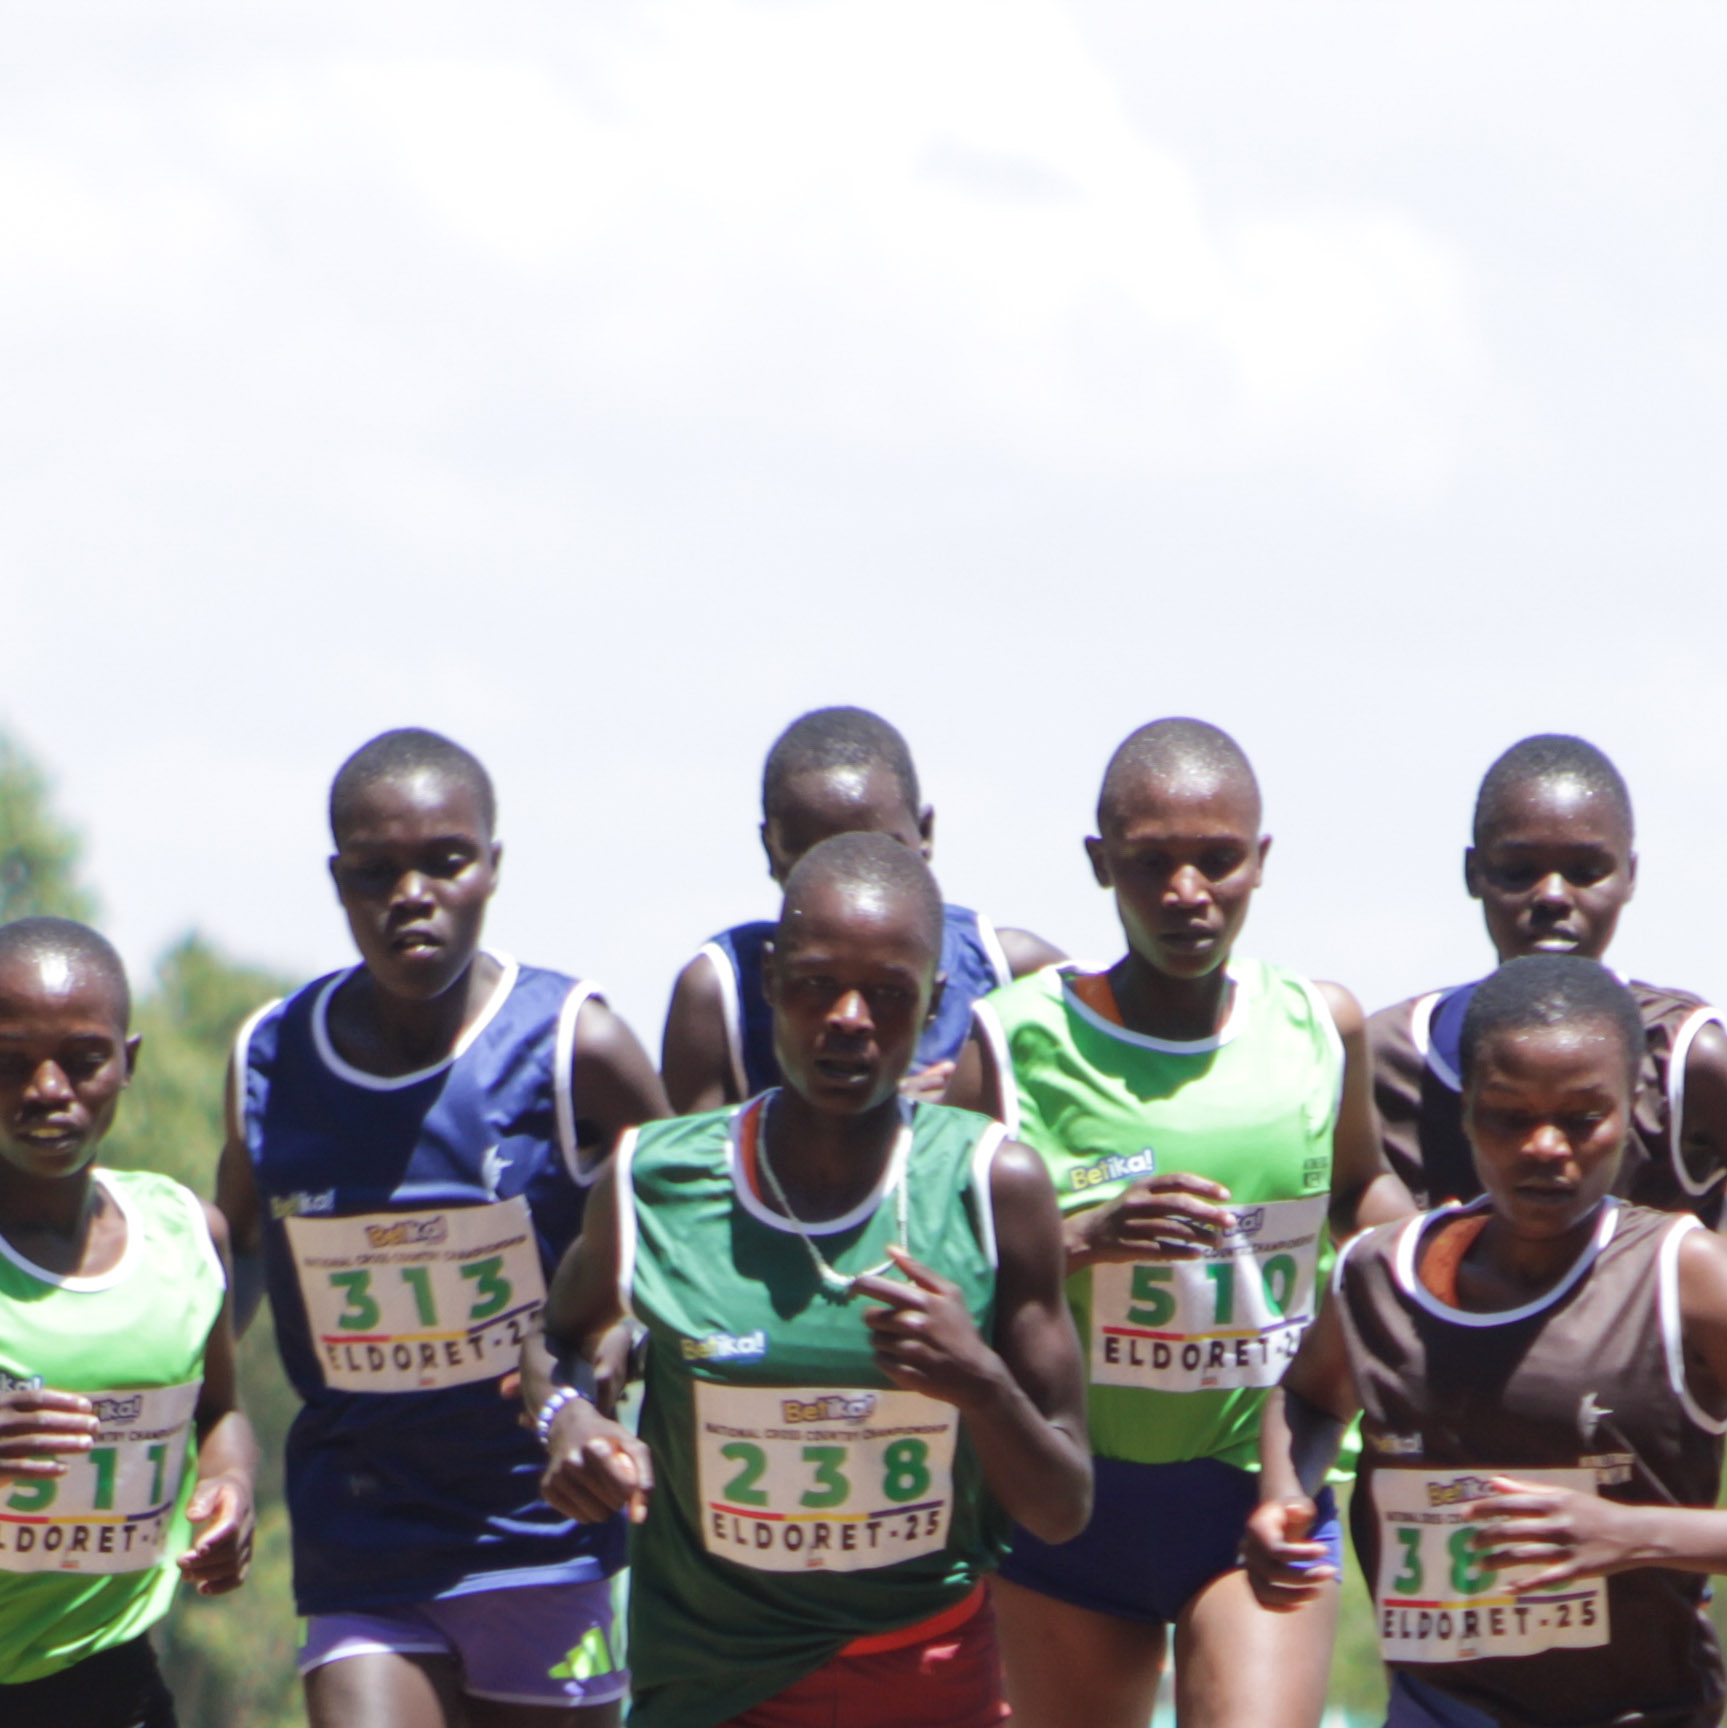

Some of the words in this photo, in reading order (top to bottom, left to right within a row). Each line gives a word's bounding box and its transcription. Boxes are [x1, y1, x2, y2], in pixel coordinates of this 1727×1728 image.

[1069, 1147, 1155, 1191] Betika!
[328, 1256, 513, 1332] 313
[1127, 1253, 1297, 1327] 510
[680, 1328, 767, 1362] Betika!
[1104, 1330, 1298, 1372] ELDORET-2
[6, 1444, 167, 1512] 511
[719, 1437, 931, 1509] 238
[711, 1510, 940, 1551] ELDORET-25
[1393, 1527, 1569, 1595] 38
[1382, 1599, 1596, 1641] ELDORET-25
